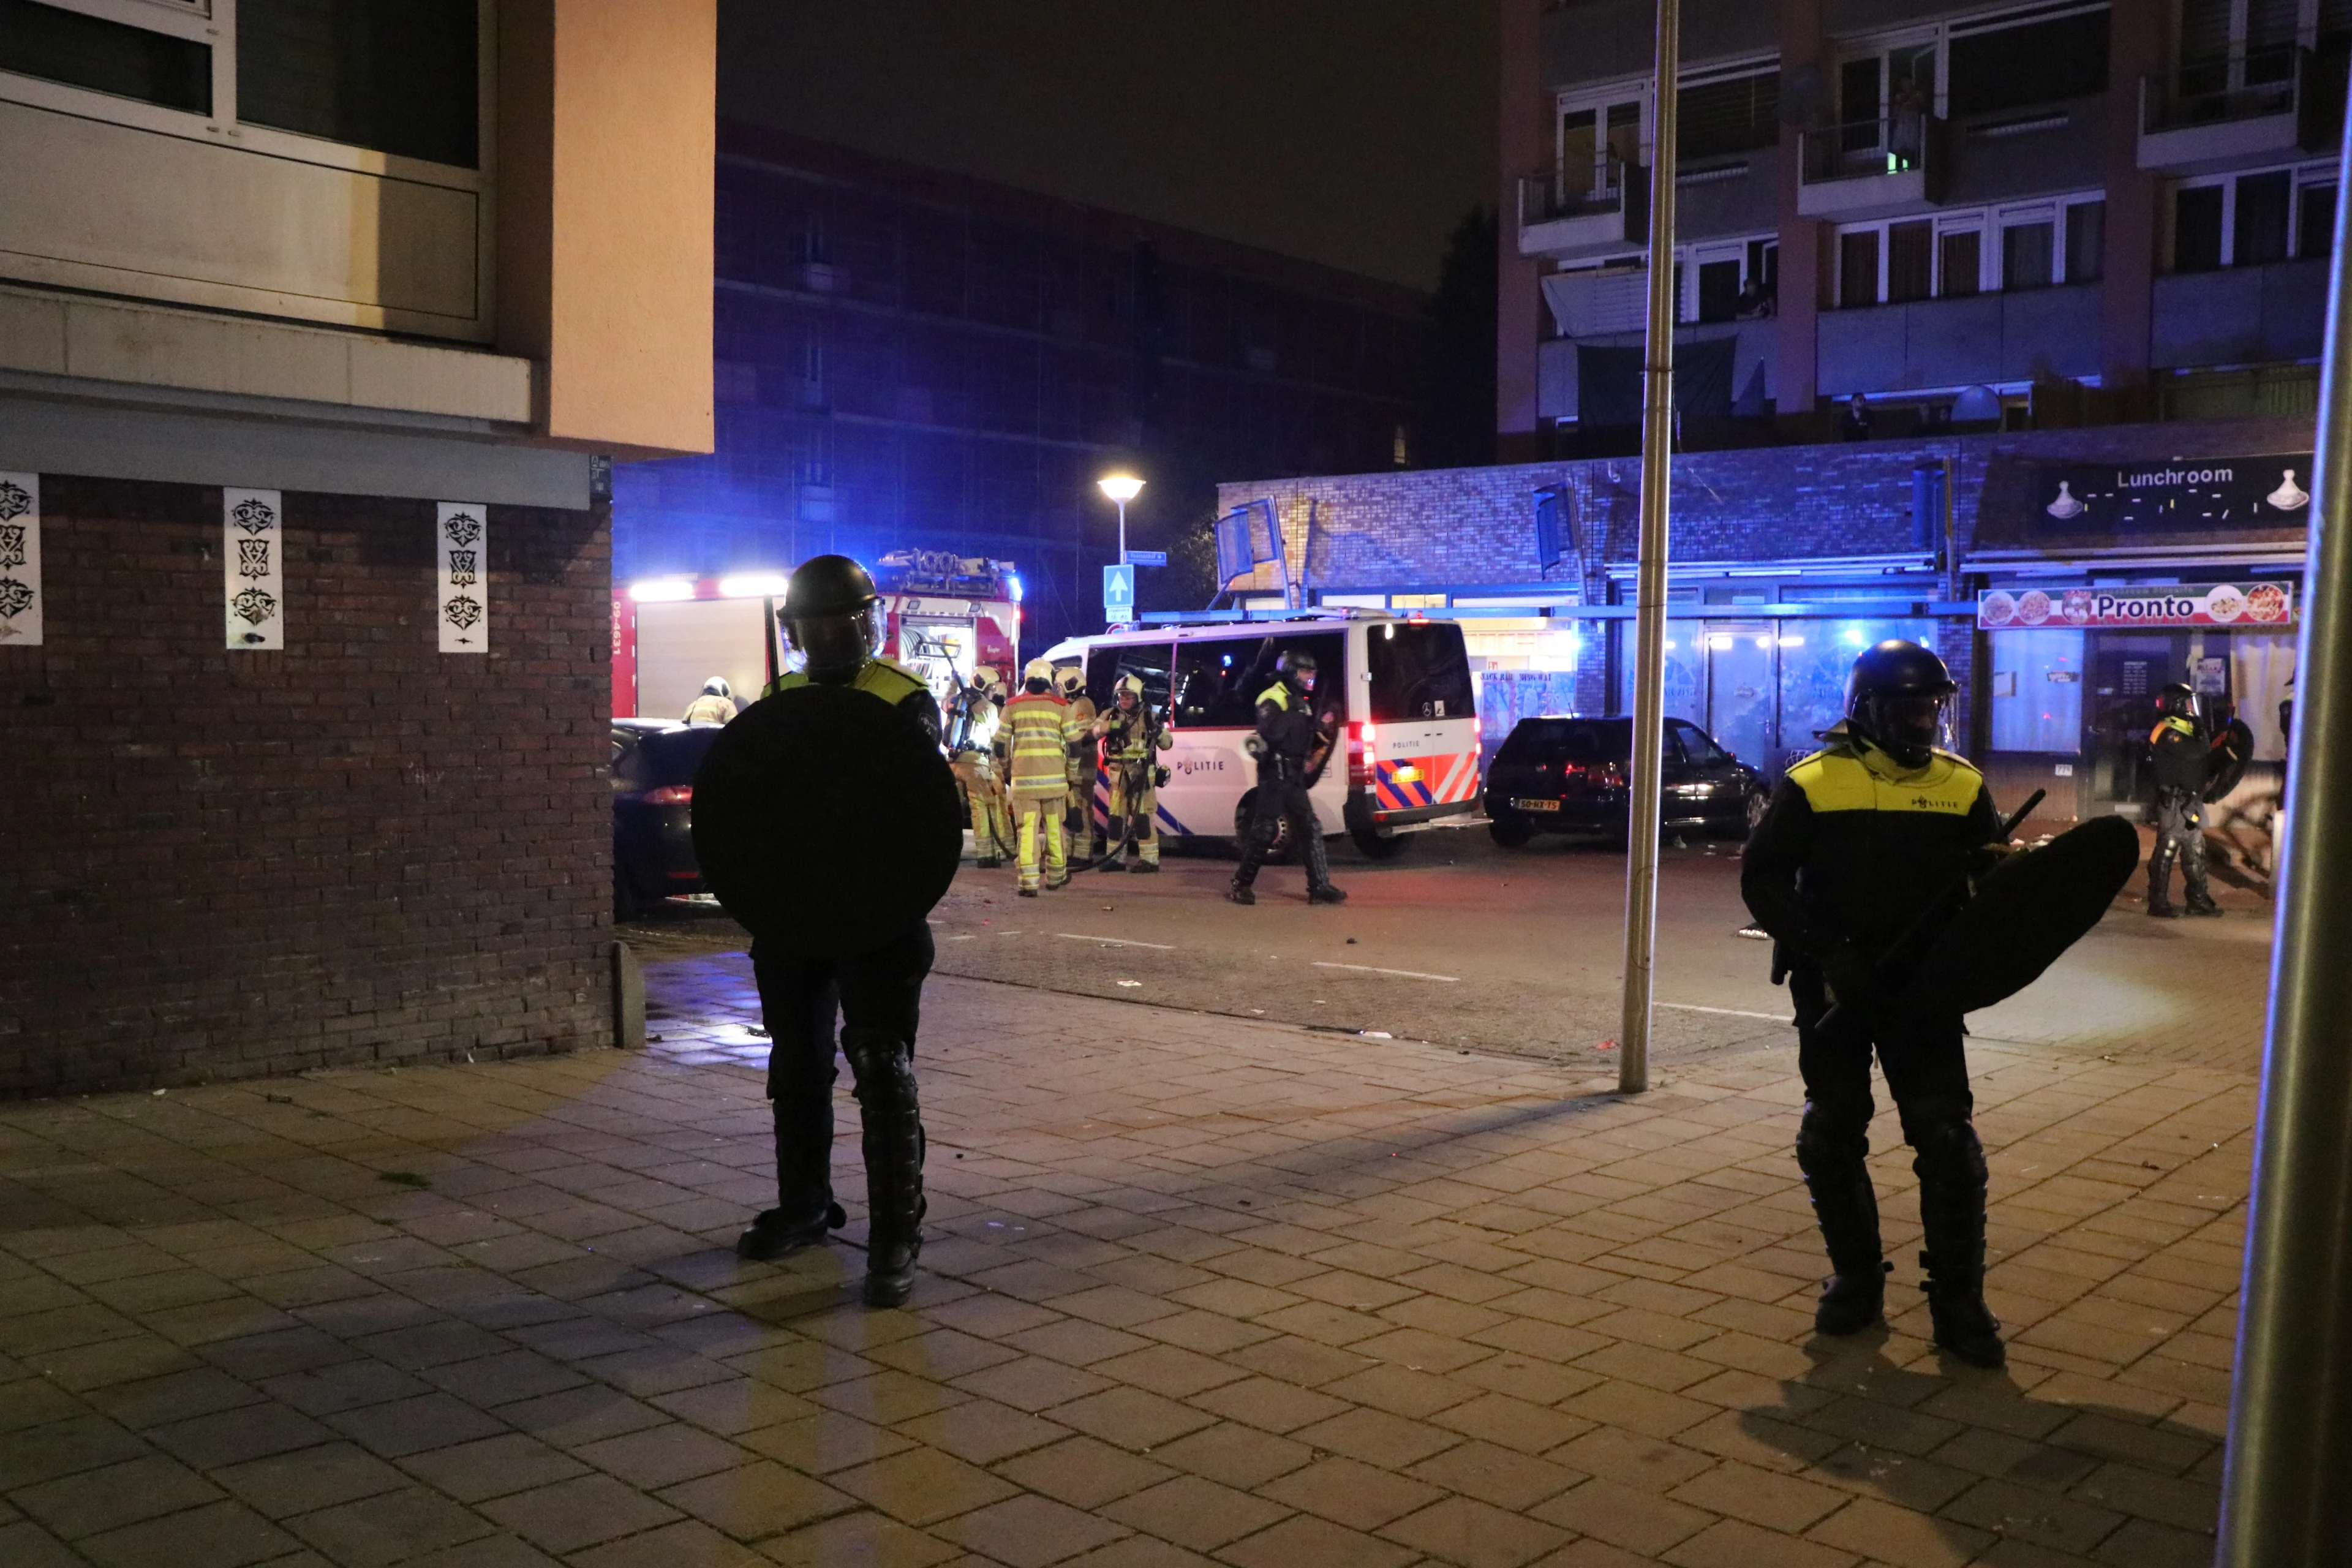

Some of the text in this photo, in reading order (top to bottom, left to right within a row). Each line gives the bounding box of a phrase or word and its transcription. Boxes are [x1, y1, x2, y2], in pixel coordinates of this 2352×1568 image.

[2117, 468, 2233, 488] Lunchroom
[2098, 595, 2194, 617] Pronto
[1392, 740, 1420, 748] POLITIE
[1177, 758, 1224, 774] POLITIE
[1911, 796, 1958, 809] POLITIE
